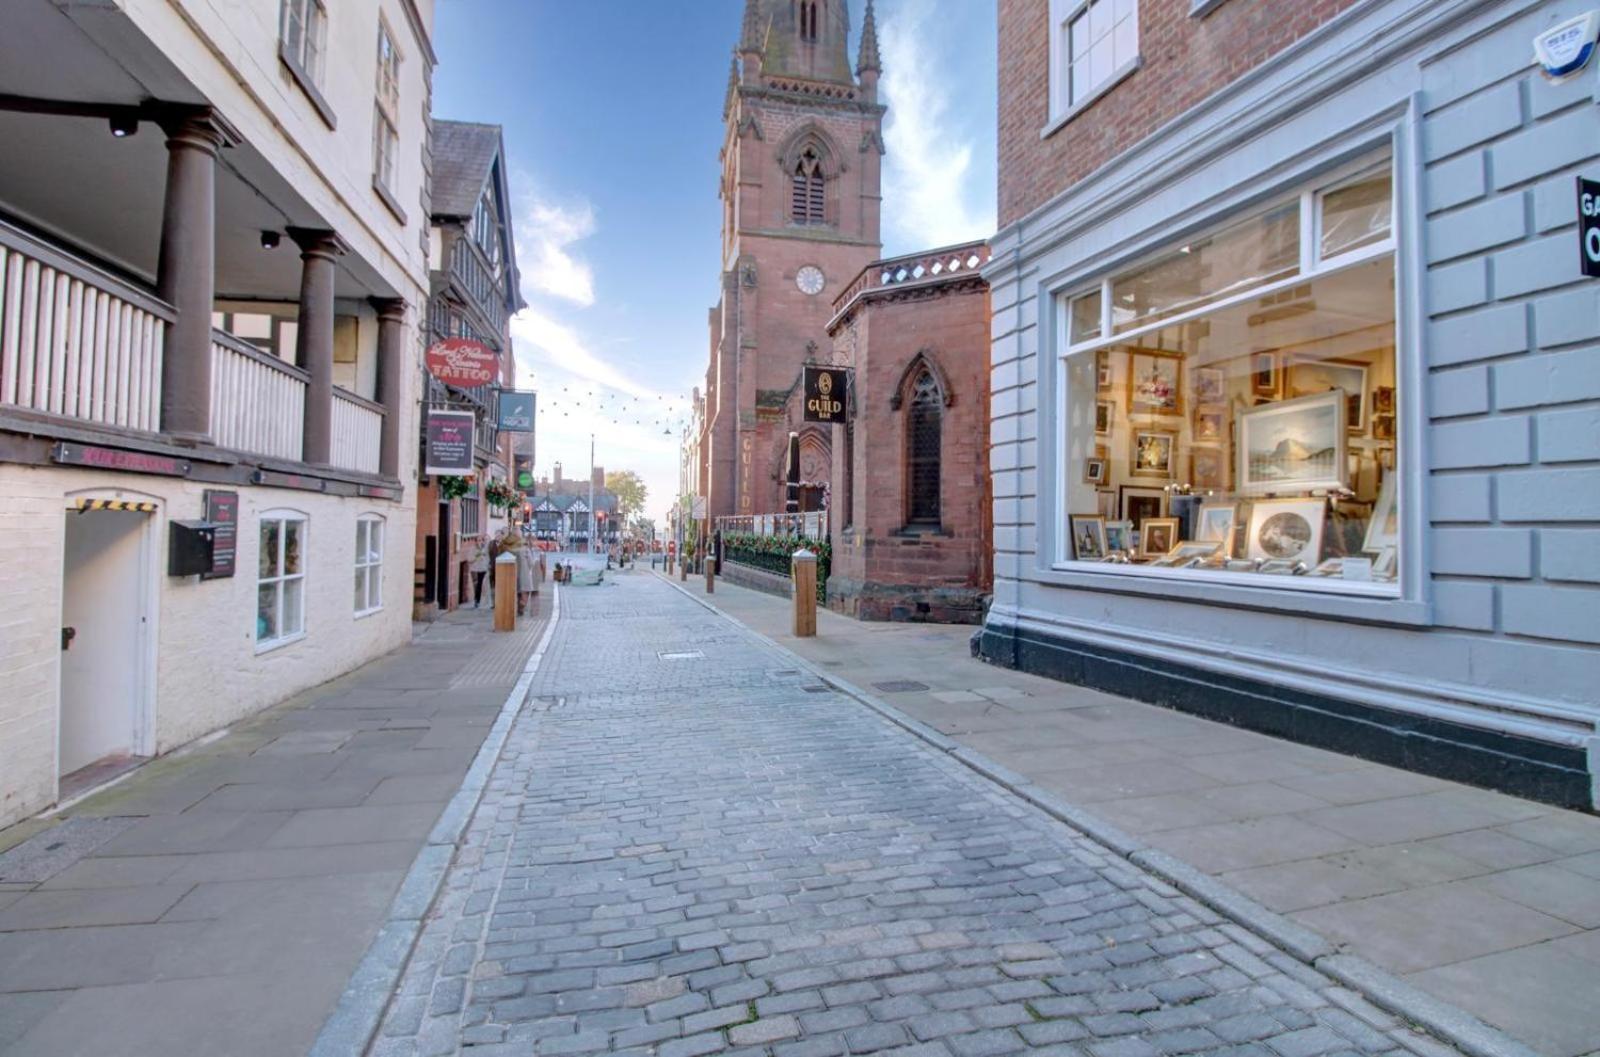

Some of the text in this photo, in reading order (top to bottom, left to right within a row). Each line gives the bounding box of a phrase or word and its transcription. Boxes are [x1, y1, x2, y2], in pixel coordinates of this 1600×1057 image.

[431, 364, 491, 380] TATTOO
[808, 399, 842, 413] GUILD
[742, 438, 752, 508] GUILD
